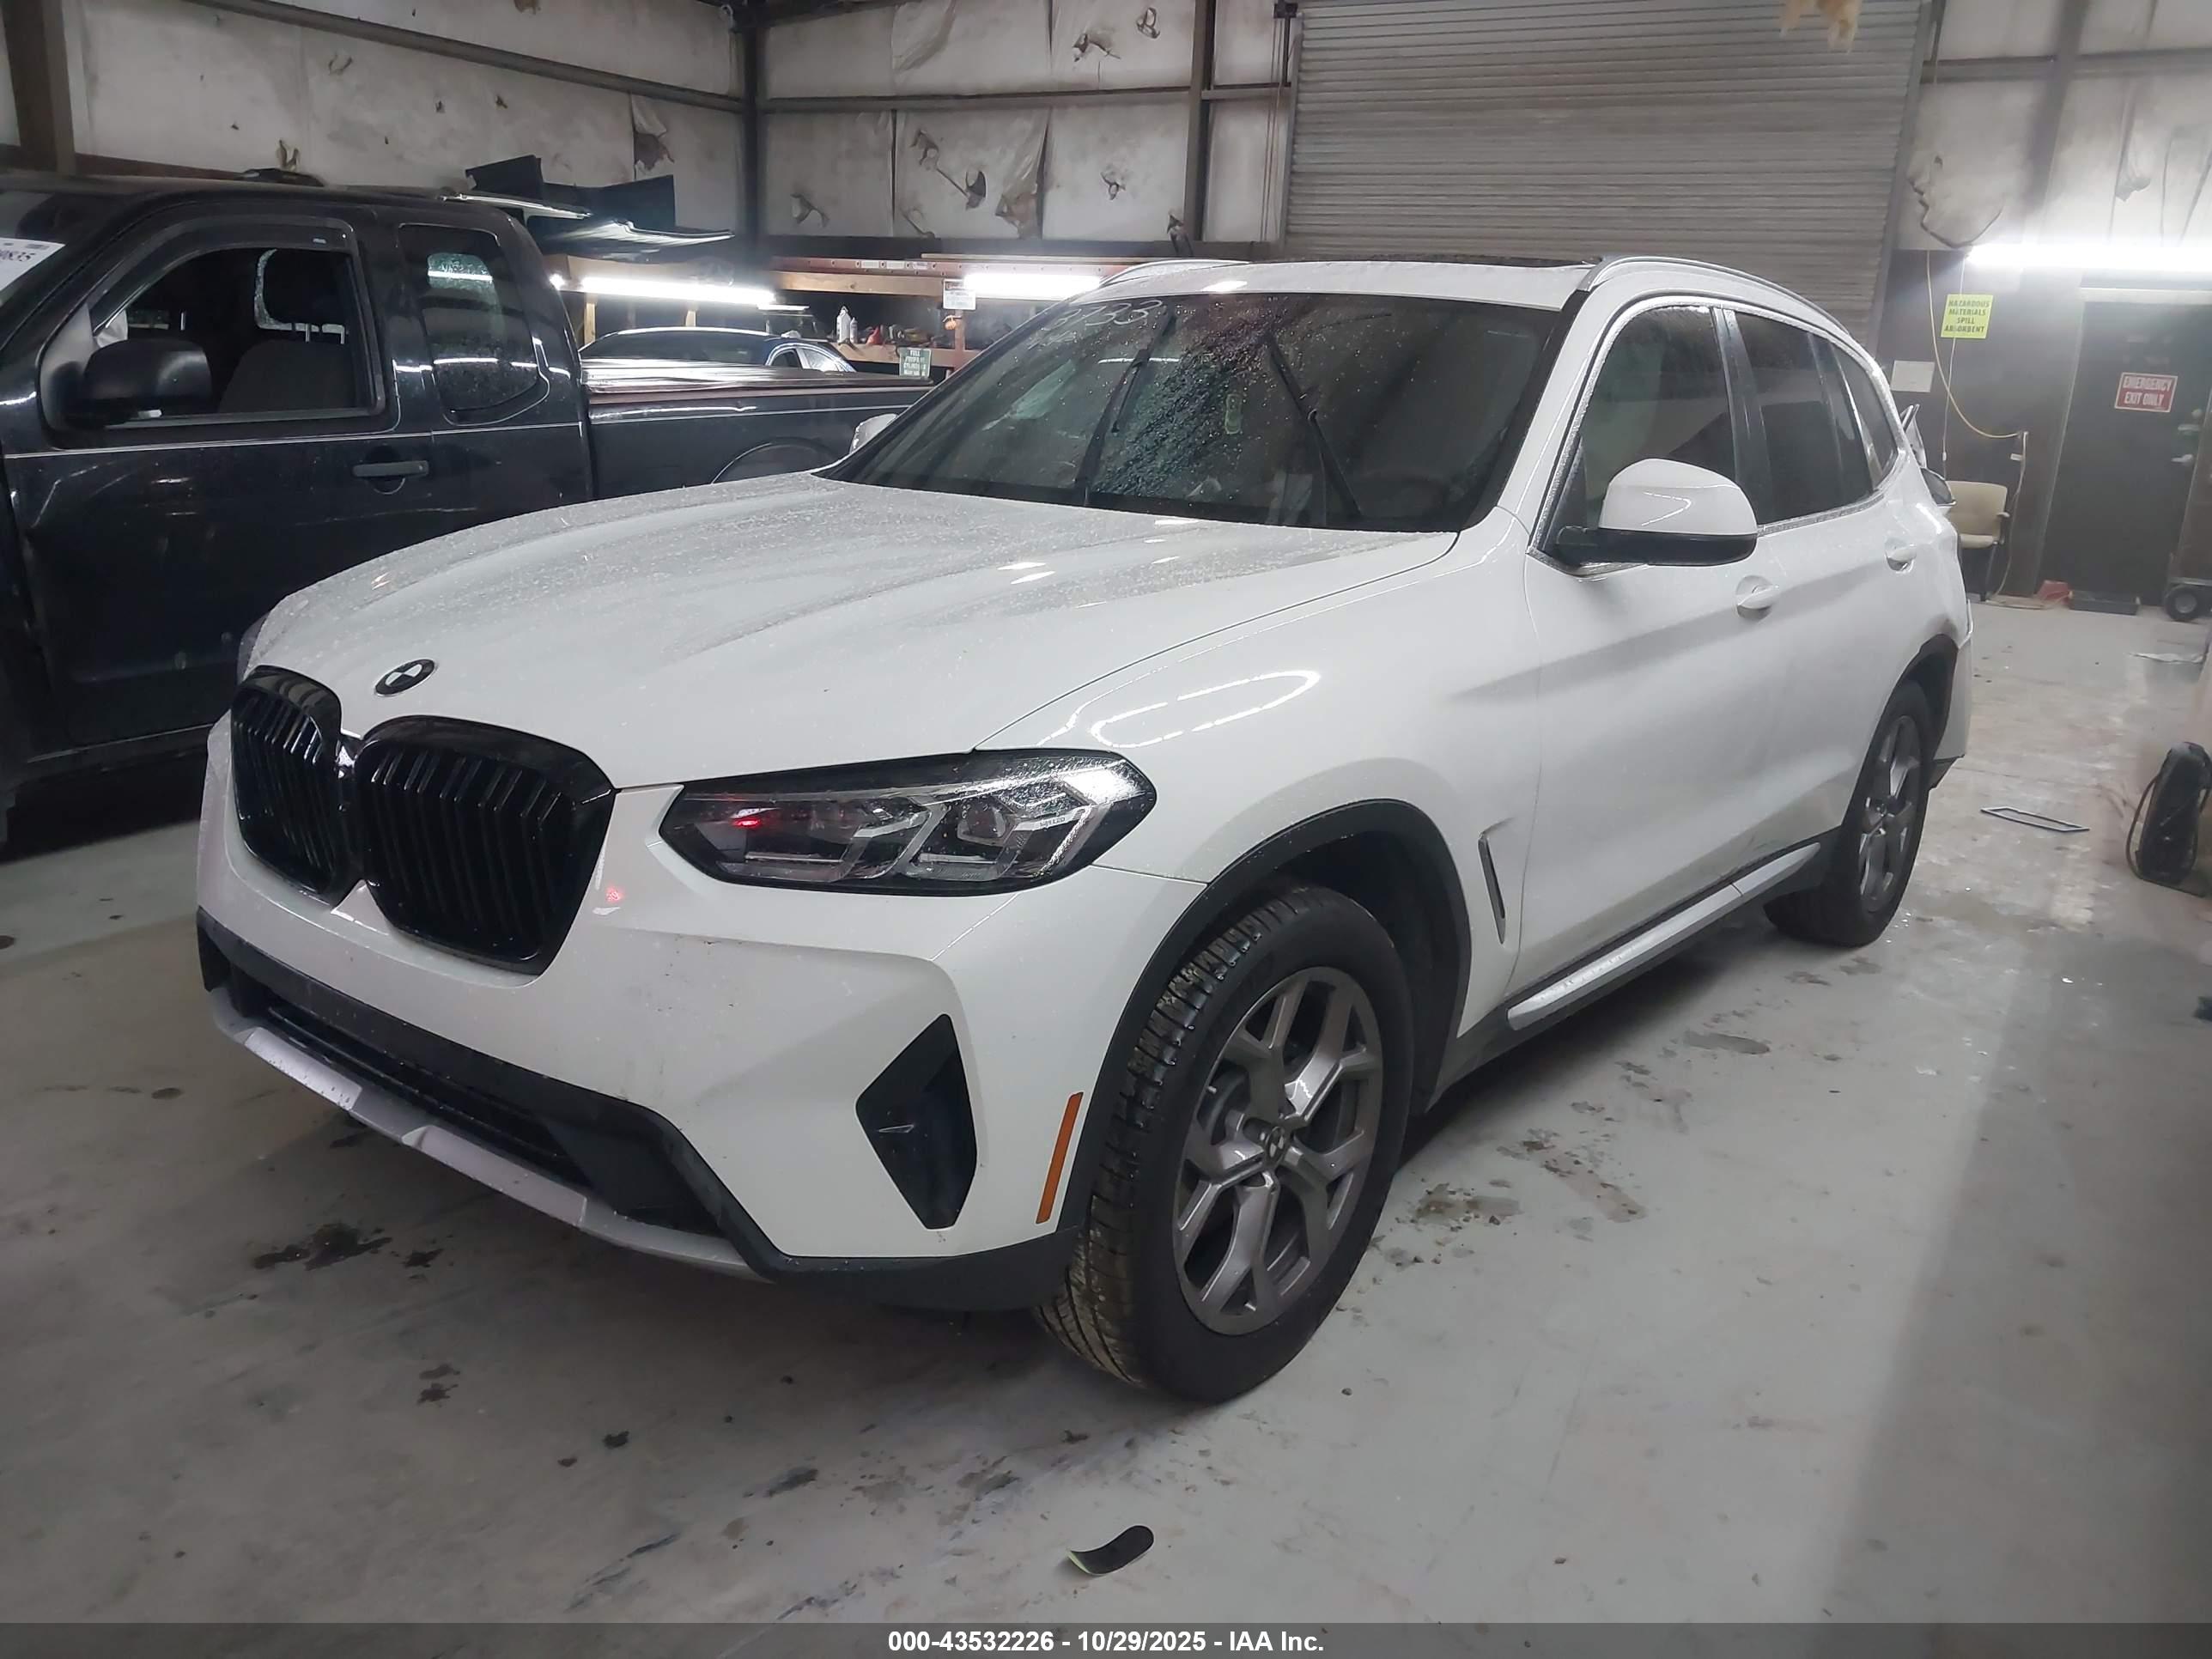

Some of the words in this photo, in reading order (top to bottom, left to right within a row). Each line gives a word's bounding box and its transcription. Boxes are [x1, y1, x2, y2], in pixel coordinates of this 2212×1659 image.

[1944, 325, 1984, 333] ABSORBENT
[2123, 376, 2172, 392] EMERGENCY
[2124, 392, 2142, 404] EXIT
[2142, 393, 2164, 406] ONLY
